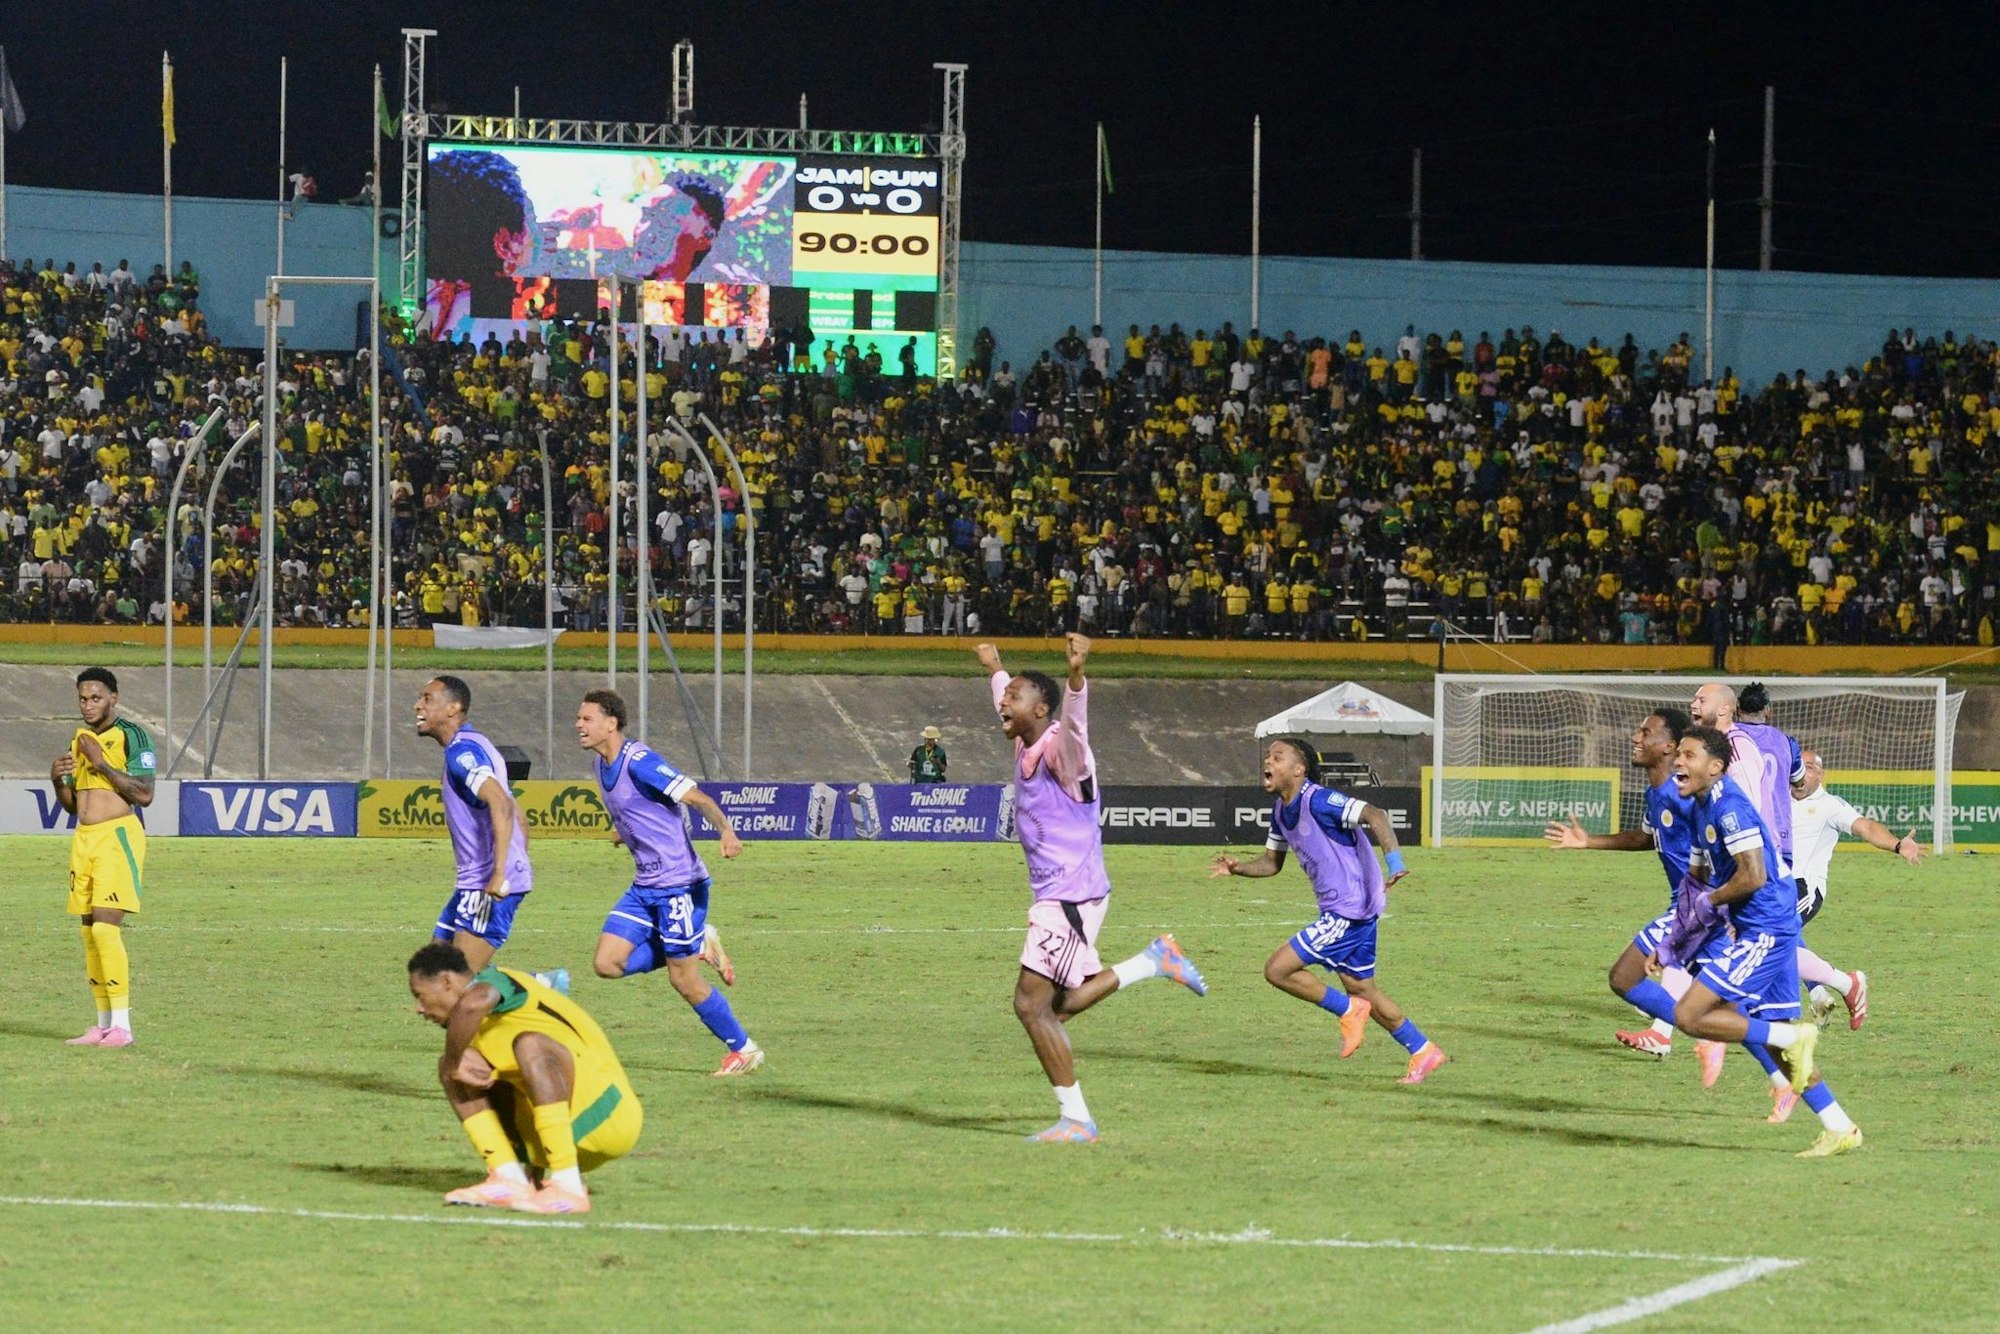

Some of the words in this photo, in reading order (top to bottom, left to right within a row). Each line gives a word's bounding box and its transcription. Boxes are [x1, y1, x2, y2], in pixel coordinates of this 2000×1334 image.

[796, 167, 862, 184] JAM
[808, 186, 844, 211] 0
[886, 189, 922, 213] 0
[799, 232, 929, 256] 90:00
[720, 787, 778, 805] TruSHAKE
[911, 788, 969, 806] TruSHAKE
[198, 788, 334, 832] VISA
[1440, 801, 1492, 817] WRAY
[1499, 801, 1515, 817] &
[1520, 801, 1605, 818] NEPHEW
[1896, 805, 1914, 821] &
[702, 815, 742, 831] SKE
[890, 816, 932, 832] SHAKE
[933, 819, 942, 833] &
[1038, 929, 1065, 957] 22
